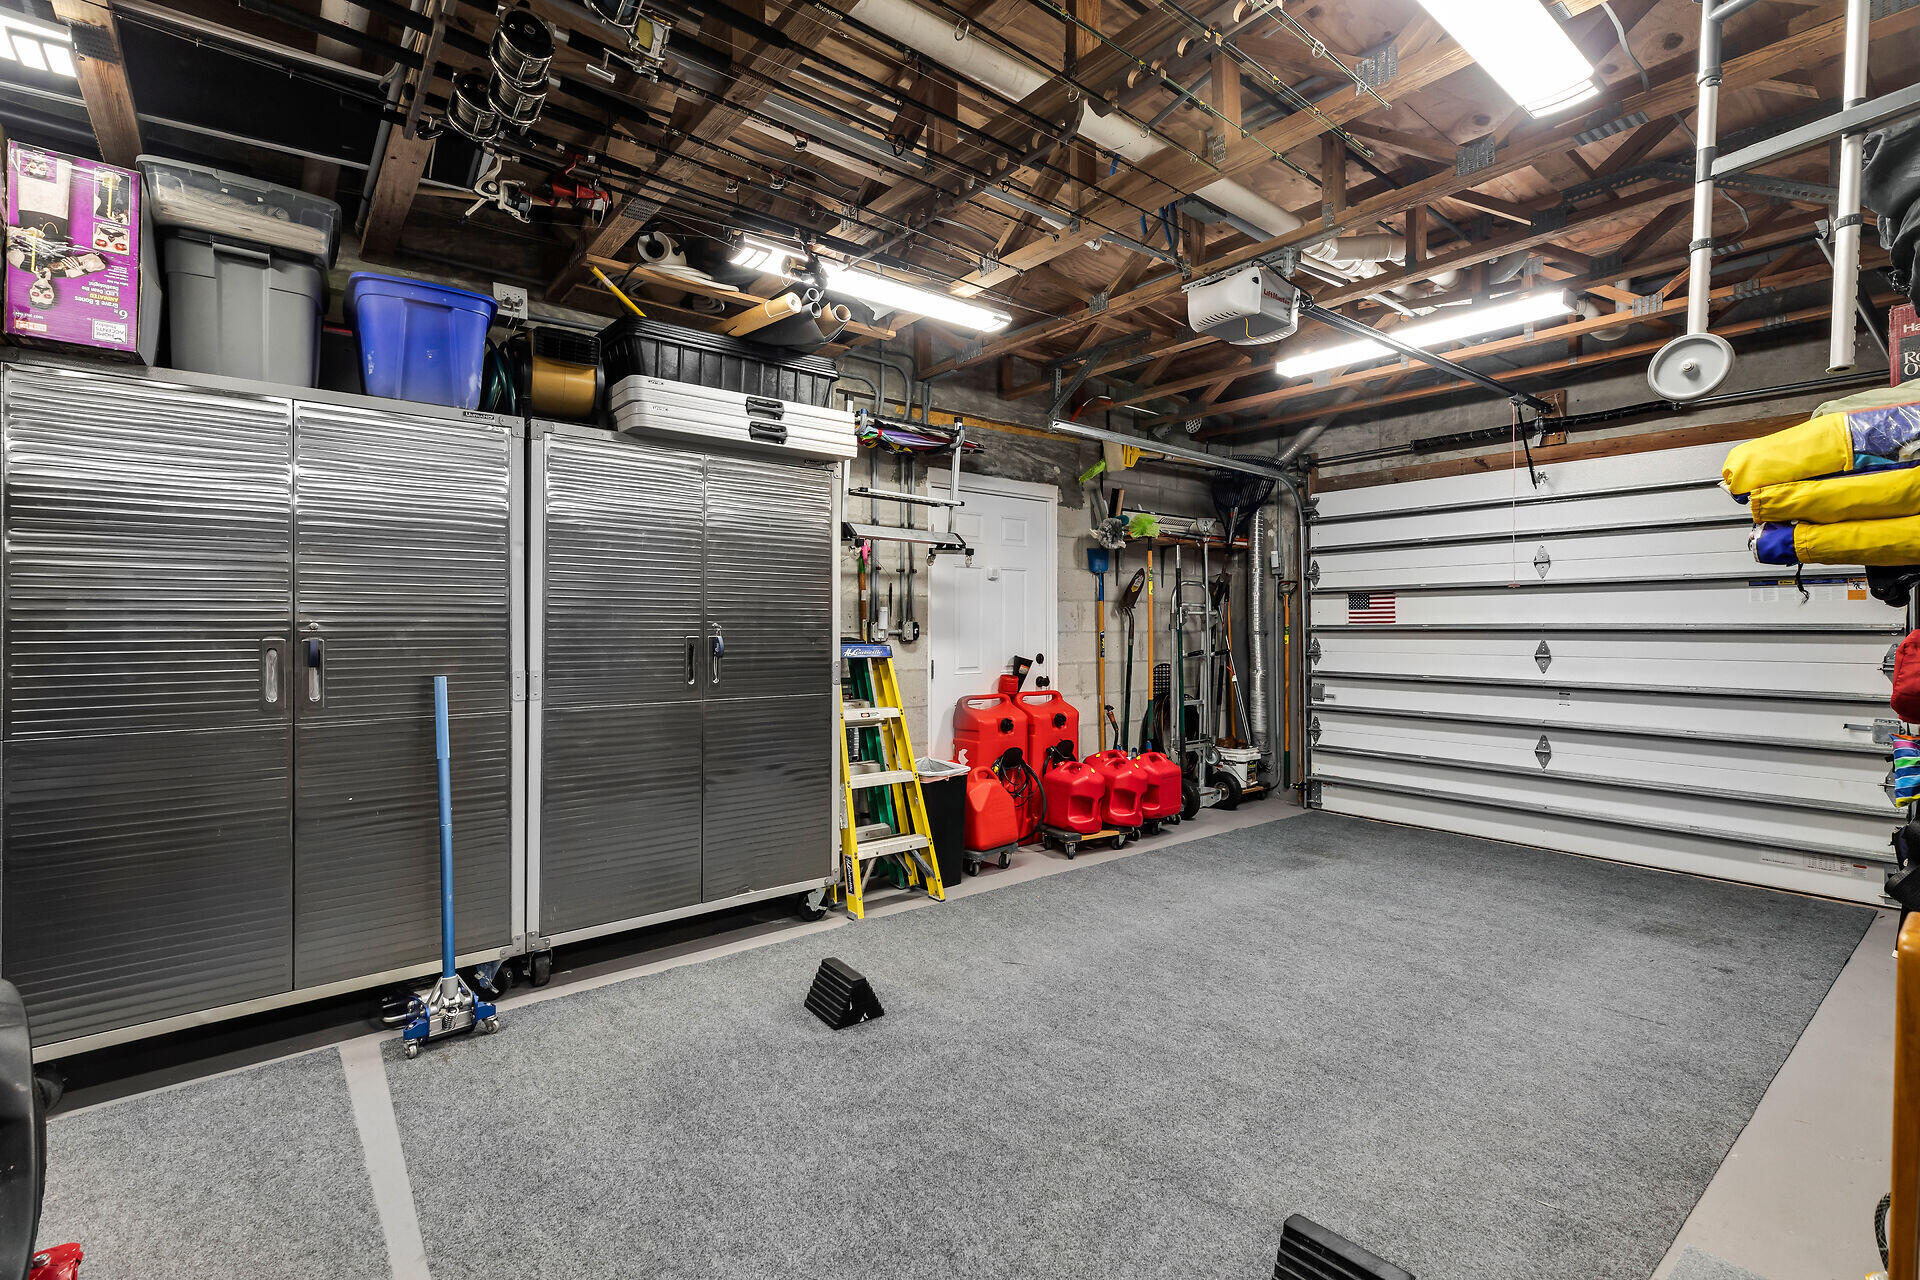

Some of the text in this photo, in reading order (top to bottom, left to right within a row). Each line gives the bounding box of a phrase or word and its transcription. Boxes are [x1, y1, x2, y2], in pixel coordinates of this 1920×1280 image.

[815, 2, 844, 21] AVENGER
[74, 295, 94, 305] Bones
[89, 293, 119, 303] ANIMATED
[1263, 288, 1290, 305] LiftMaster
[101, 300, 119, 309] Grave
[118, 309, 129, 320] 6
[95, 326, 124, 335] ACCENTS
